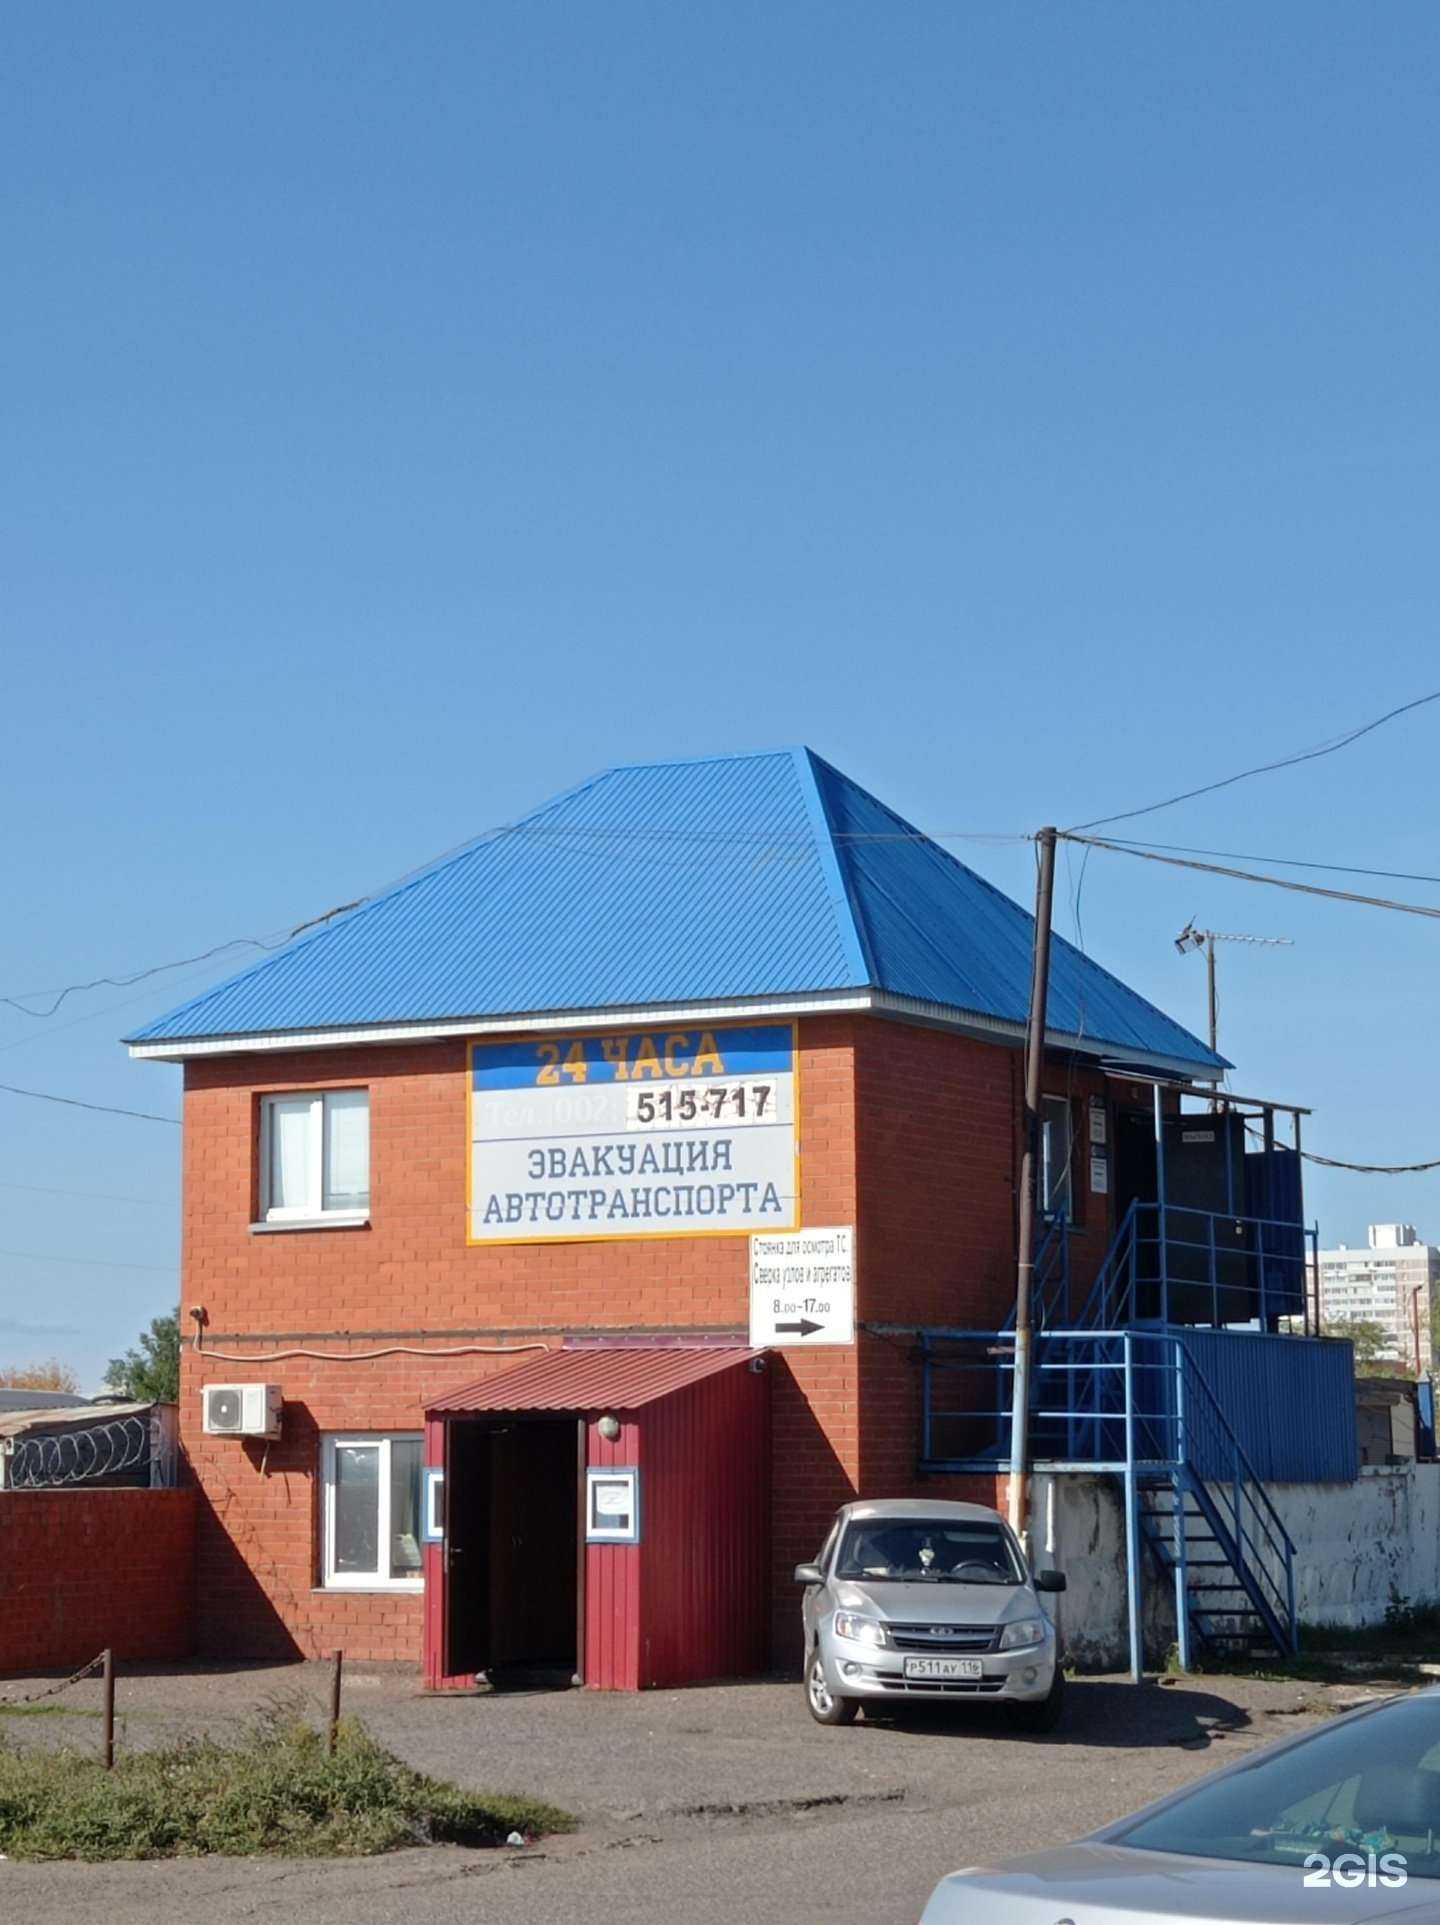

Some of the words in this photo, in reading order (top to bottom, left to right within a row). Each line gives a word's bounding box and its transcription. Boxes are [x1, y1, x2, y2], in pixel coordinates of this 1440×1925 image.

[535, 1041, 588, 1086] 24
[601, 1032, 725, 1081] ЧАСА
[637, 1085, 771, 1123] 515-717
[527, 1139, 733, 1180] ЭВАКУАЦИЯ
[482, 1182, 783, 1224] АВТОТРАНСПОРТА
